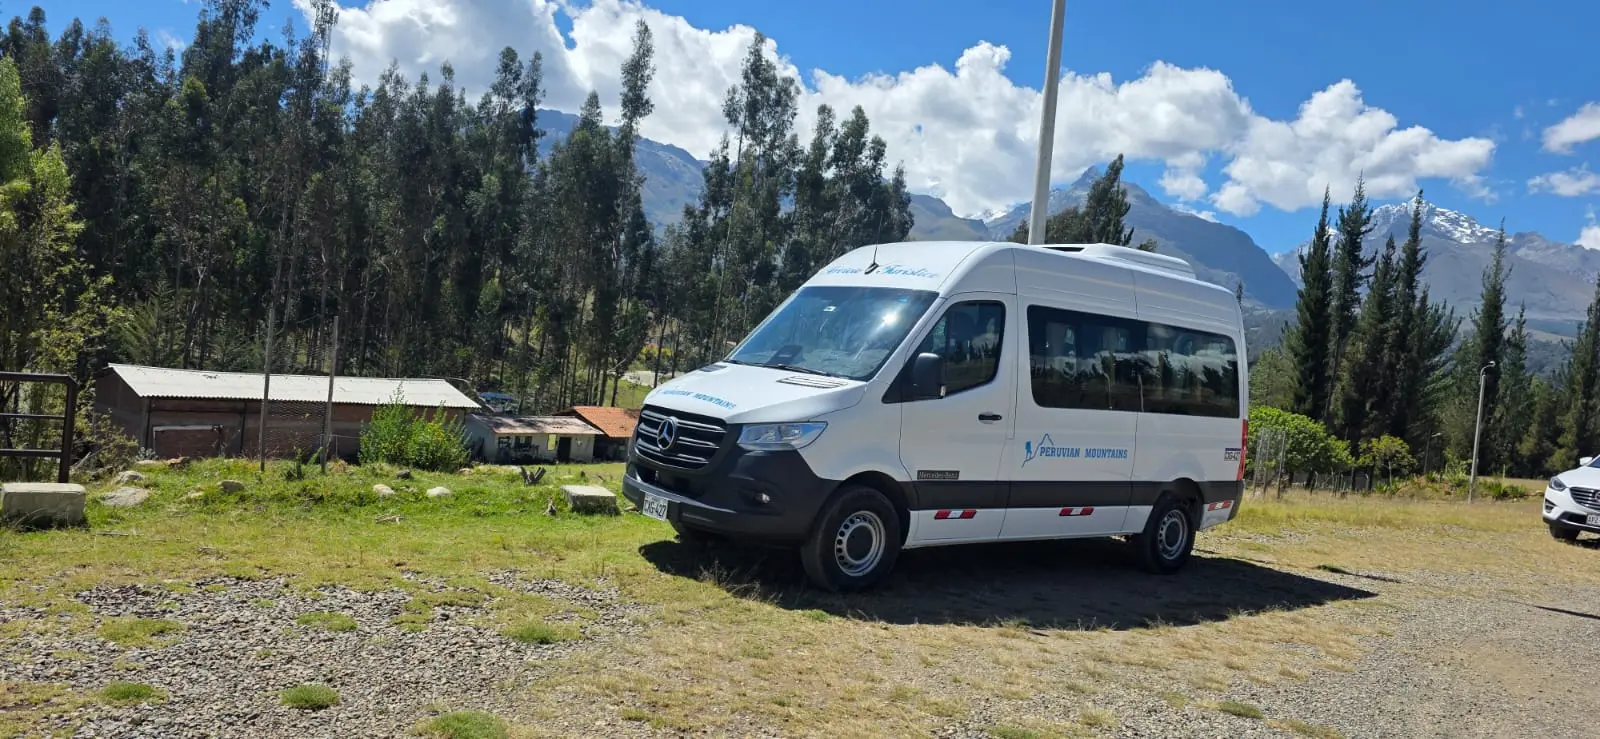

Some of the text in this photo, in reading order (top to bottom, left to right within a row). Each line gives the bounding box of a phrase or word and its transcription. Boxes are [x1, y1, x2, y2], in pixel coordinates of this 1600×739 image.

[692, 392, 736, 409] MOUNTAINS
[1039, 446, 1128, 459] PERUVIAN MOUNTAINS
